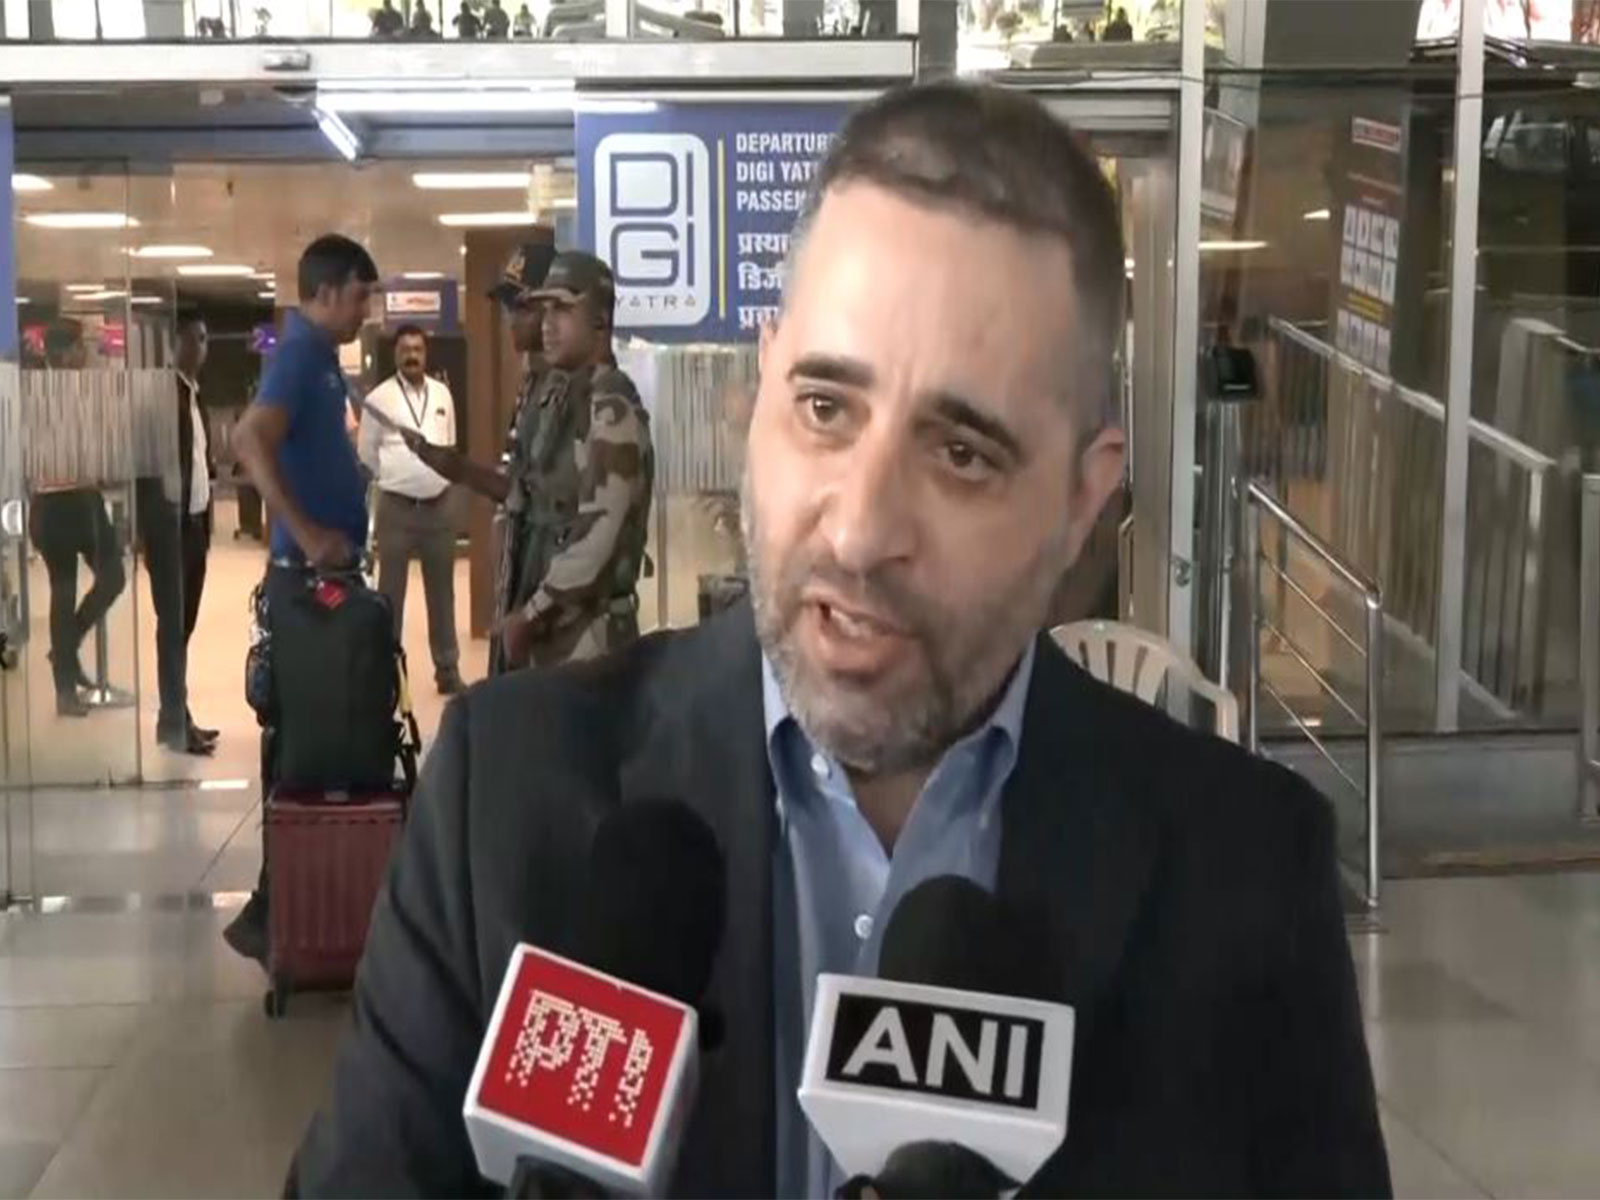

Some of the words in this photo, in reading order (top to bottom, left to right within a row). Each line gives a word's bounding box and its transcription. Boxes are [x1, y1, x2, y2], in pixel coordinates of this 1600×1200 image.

[736, 133, 841, 153] DEPARTUR
[736, 161, 774, 182] DIGI
[841, 1006, 1028, 1099] ANI
